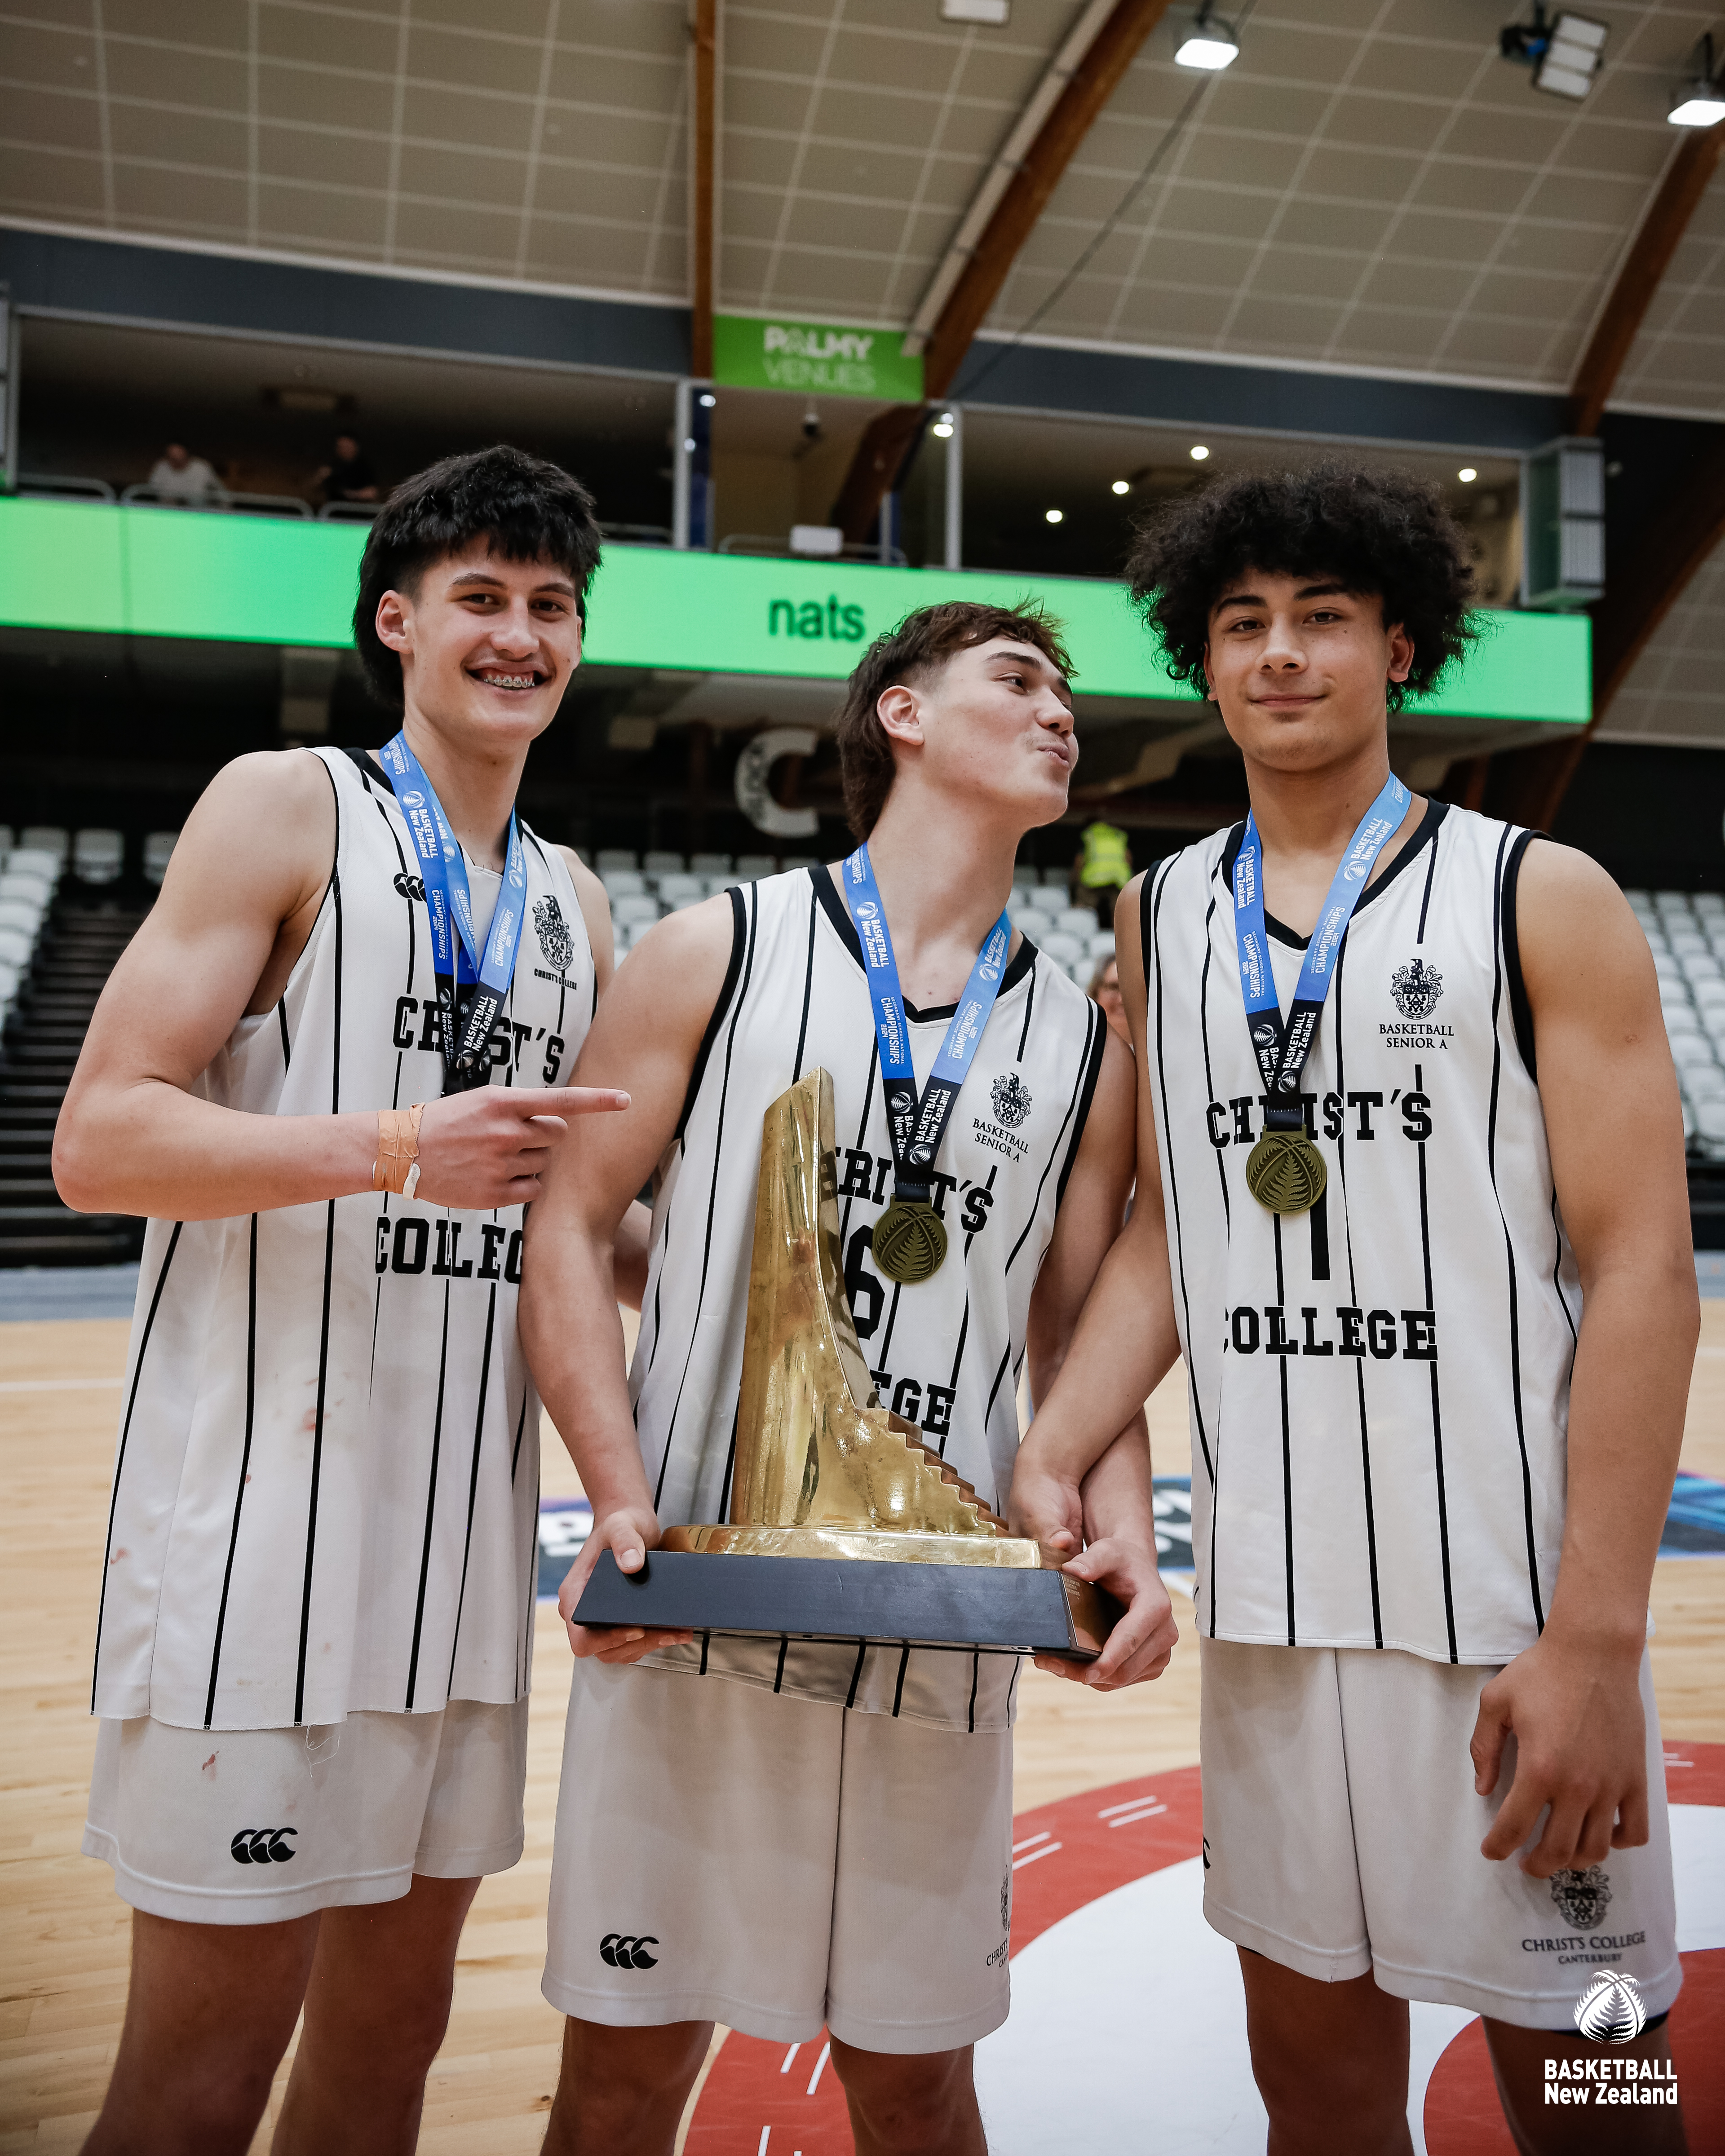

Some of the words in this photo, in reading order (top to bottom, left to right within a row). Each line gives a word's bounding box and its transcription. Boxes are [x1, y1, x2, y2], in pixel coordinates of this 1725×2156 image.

[765, 326, 873, 360] PALMY
[769, 595, 865, 641] nats
[408, 809, 420, 826] New
[418, 808, 438, 858] BASKETBALL
[413, 826, 430, 859] Zealand
[1350, 817, 1383, 860] BASKETBALL
[1360, 844, 1376, 861] New
[1370, 821, 1393, 845] Zealand
[1236, 862, 1246, 878] New
[1245, 858, 1255, 906] BASKETBALL
[1237, 878, 1247, 910] Zealand
[432, 889, 446, 960] CHAMPIONSHIPS
[495, 909, 514, 967] CHAMPIONSHIPS
[861, 920, 872, 937] New
[1315, 906, 1345, 973] CHAMPIONSHIPS
[1316, 927, 1325, 946] SCHOOLS
[1322, 906, 1336, 926] NATIONAL
[1331, 932, 1340, 947] 2024
[865, 937, 881, 968] Zealand
[871, 919, 890, 968] BASKETBALL
[984, 926, 1002, 964] BASKETBALL
[1252, 931, 1261, 954] SECONDARY
[1243, 933, 1261, 998] CHAMPIONSHIPS
[464, 996, 489, 1048] BASKETBALL
[472, 1033, 486, 1051] New
[479, 997, 498, 1032] Zealand
[891, 996, 900, 1021] SECONDARY
[880, 997, 900, 1065] CHAMPIONSHIPS
[880, 1024, 889, 1038] 2024
[952, 1002, 982, 1059] CHAMPIONSHIPS
[968, 1026, 978, 1039] 2024
[1282, 1012, 1307, 1069] BASKETBALL
[1291, 1049, 1305, 1069] New
[1298, 1012, 1316, 1048] Zealand
[1379, 1024, 1454, 1036] BASKETBALL
[1386, 1037, 1436, 1048] SENIOR
[1439, 1038, 1448, 1049] A
[1259, 1049, 1271, 1069] New
[915, 1089, 941, 1142] BASKETBALL
[931, 1090, 951, 1123] Zealand
[894, 1116, 904, 1136] New
[924, 1123, 939, 1143] New
[973, 1118, 1029, 1154] BASKETBALL
[975, 1133, 1012, 1158] SENIOR
[1013, 1153, 1020, 1163] A
[1223, 1306, 1438, 1360] OLLEGE
[1522, 1936, 1585, 1952] CHRIST'S
[1589, 1931, 1646, 1950] COLLEGE
[1558, 1953, 1622, 1965] CANTERBURY
